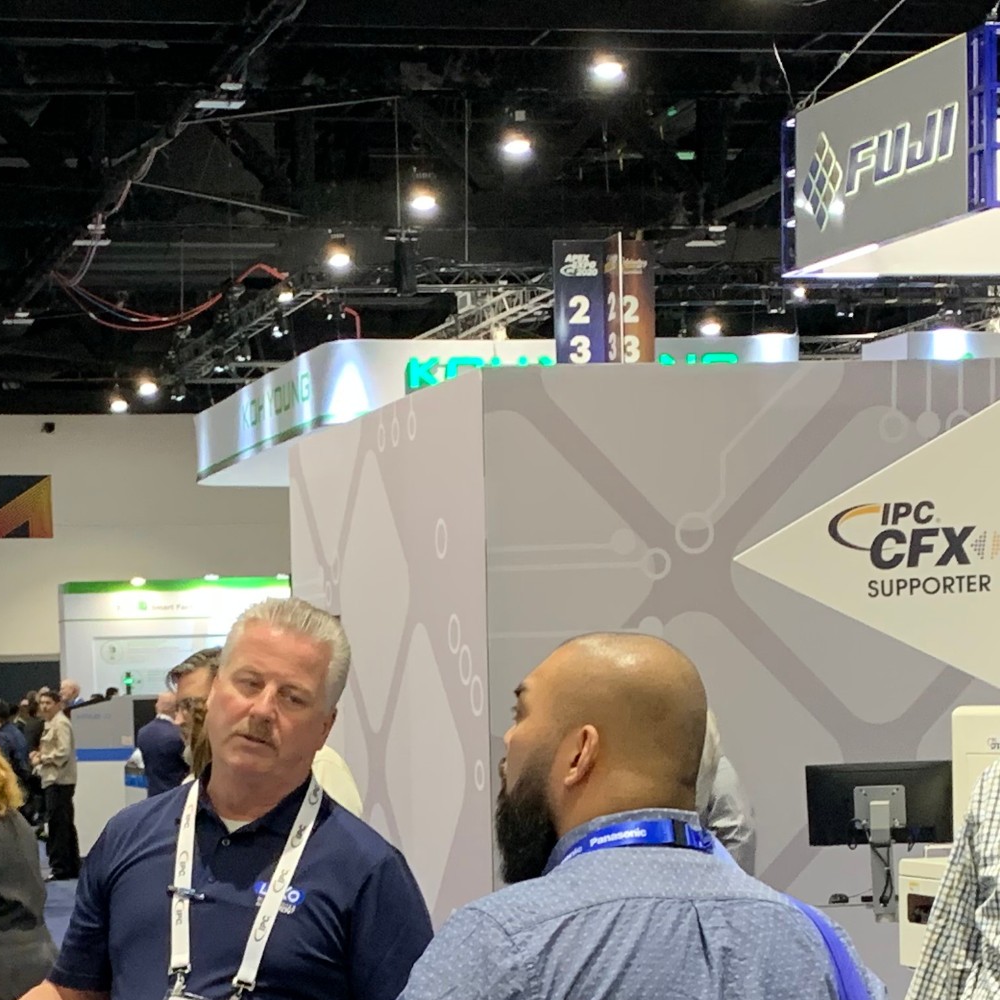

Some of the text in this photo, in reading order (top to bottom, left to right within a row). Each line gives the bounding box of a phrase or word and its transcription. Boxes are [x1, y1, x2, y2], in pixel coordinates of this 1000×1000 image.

[845, 101, 959, 197] FUJI
[881, 500, 935, 526] IPC
[870, 526, 976, 570] CFX
[868, 574, 991, 598] SUPPORTER
[590, 827, 647, 847] Panasonic
